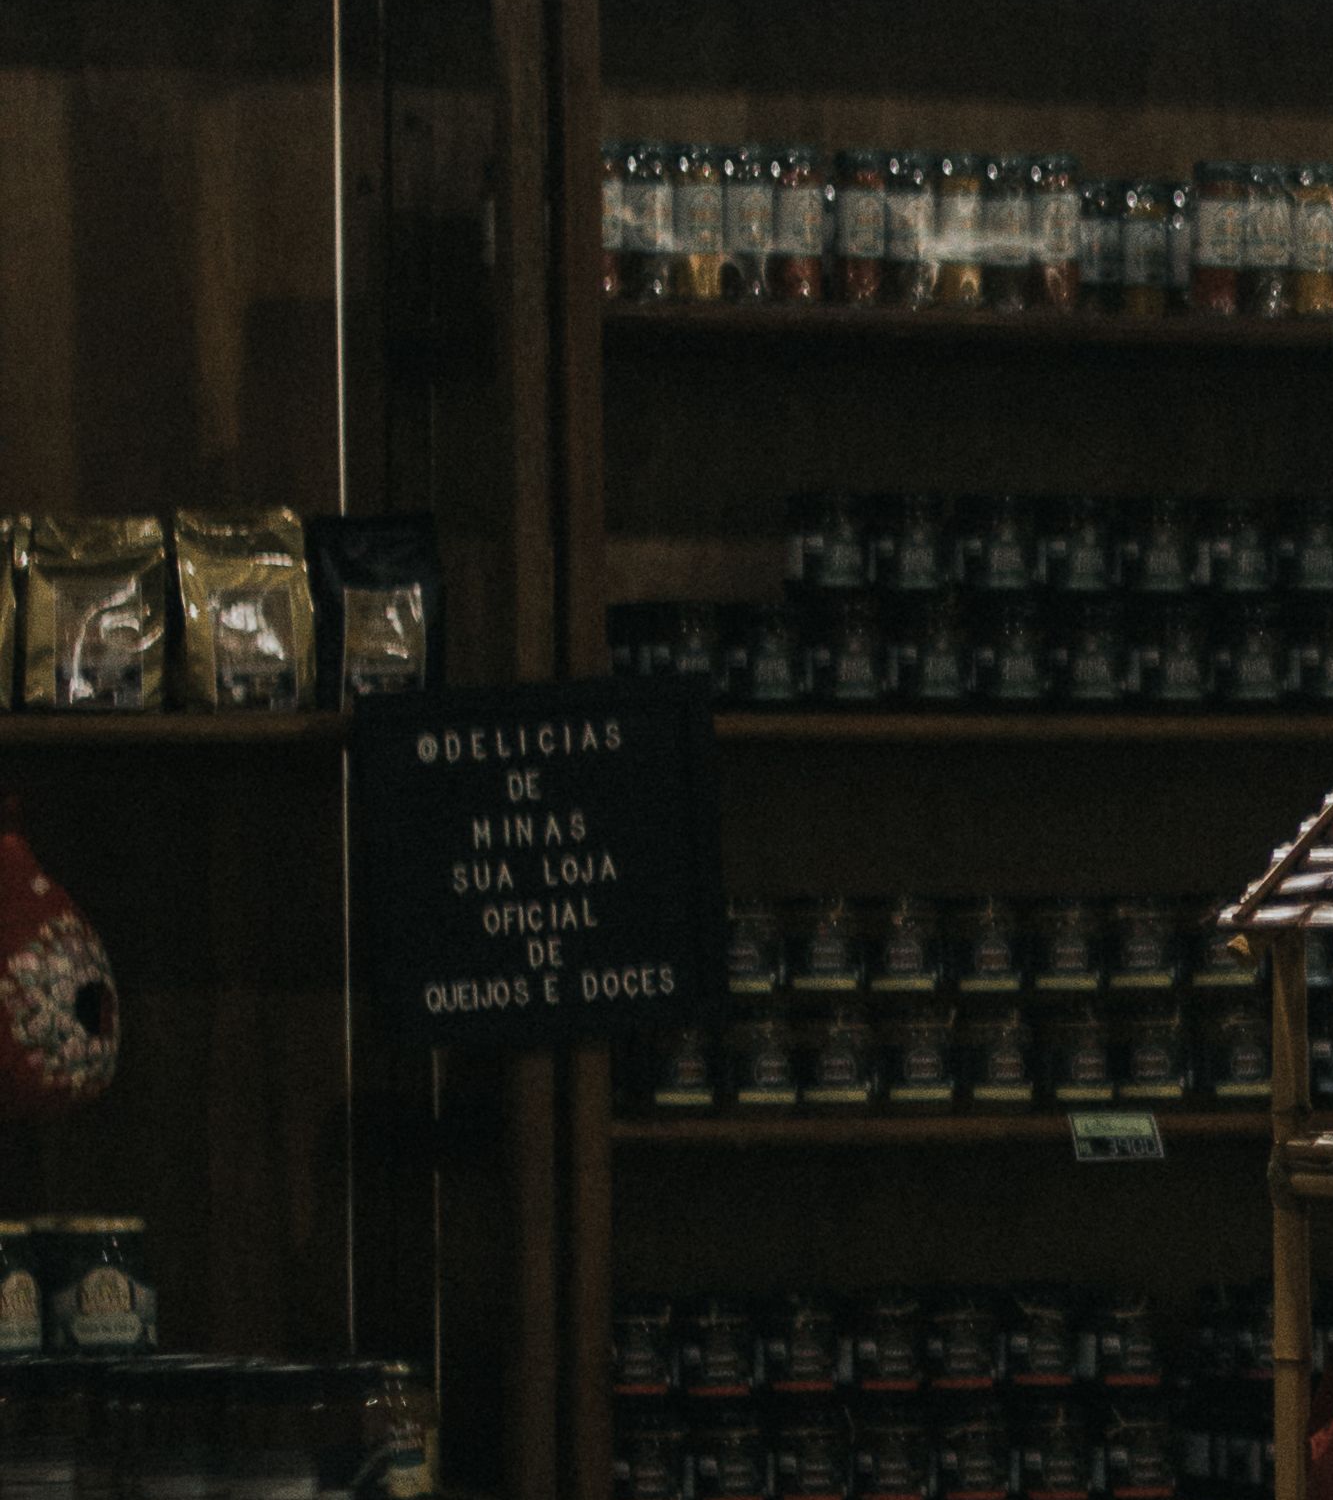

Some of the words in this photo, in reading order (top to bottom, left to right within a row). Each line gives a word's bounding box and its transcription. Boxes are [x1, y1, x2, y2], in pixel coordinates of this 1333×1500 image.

[417, 721, 622, 763] @DELICIAS
[507, 770, 541, 802] DE
[473, 811, 587, 850] MINAS
[452, 863, 514, 894] SUA
[543, 854, 617, 887] LOJA
[483, 899, 598, 935] OFICIAL
[527, 939, 564, 969] DE
[425, 979, 530, 1013] QUEIJOS
[544, 975, 561, 1003] E
[581, 967, 676, 998] DOCES
